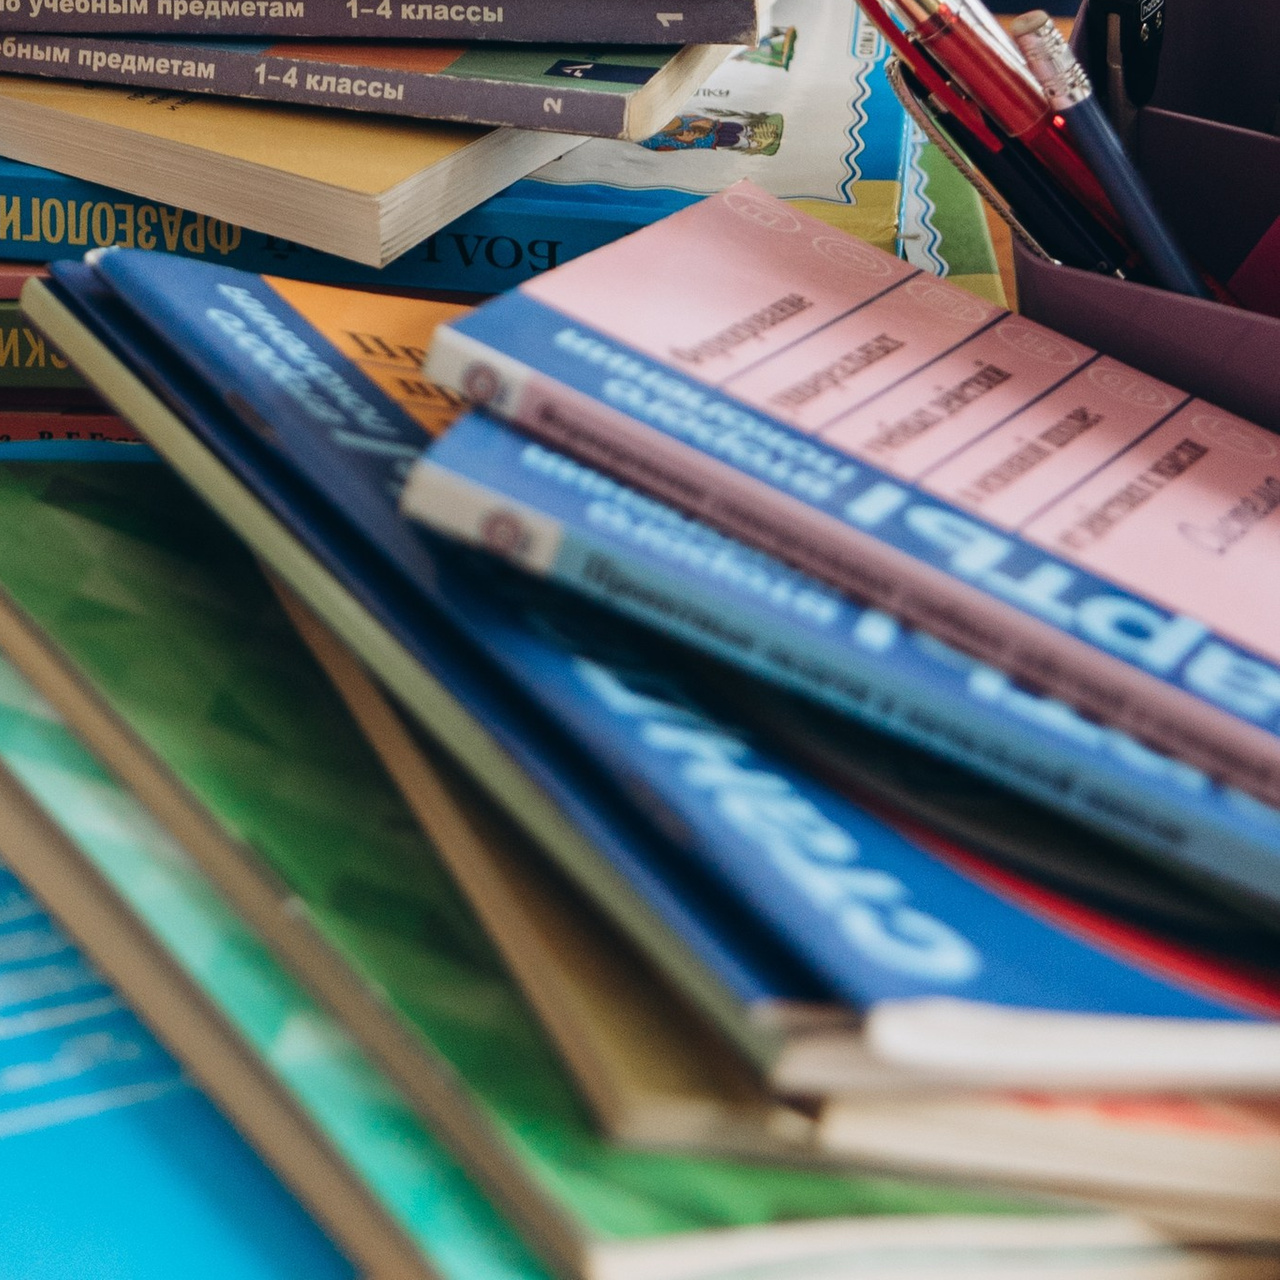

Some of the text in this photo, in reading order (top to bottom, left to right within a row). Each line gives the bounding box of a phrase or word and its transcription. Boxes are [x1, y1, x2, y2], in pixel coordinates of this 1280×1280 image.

[400, 0, 505, 24] классы
[655, 12, 684, 28] 1
[77, 47, 217, 82] предметам
[305, 74, 405, 102] классы
[543, 96, 562, 115] 2
